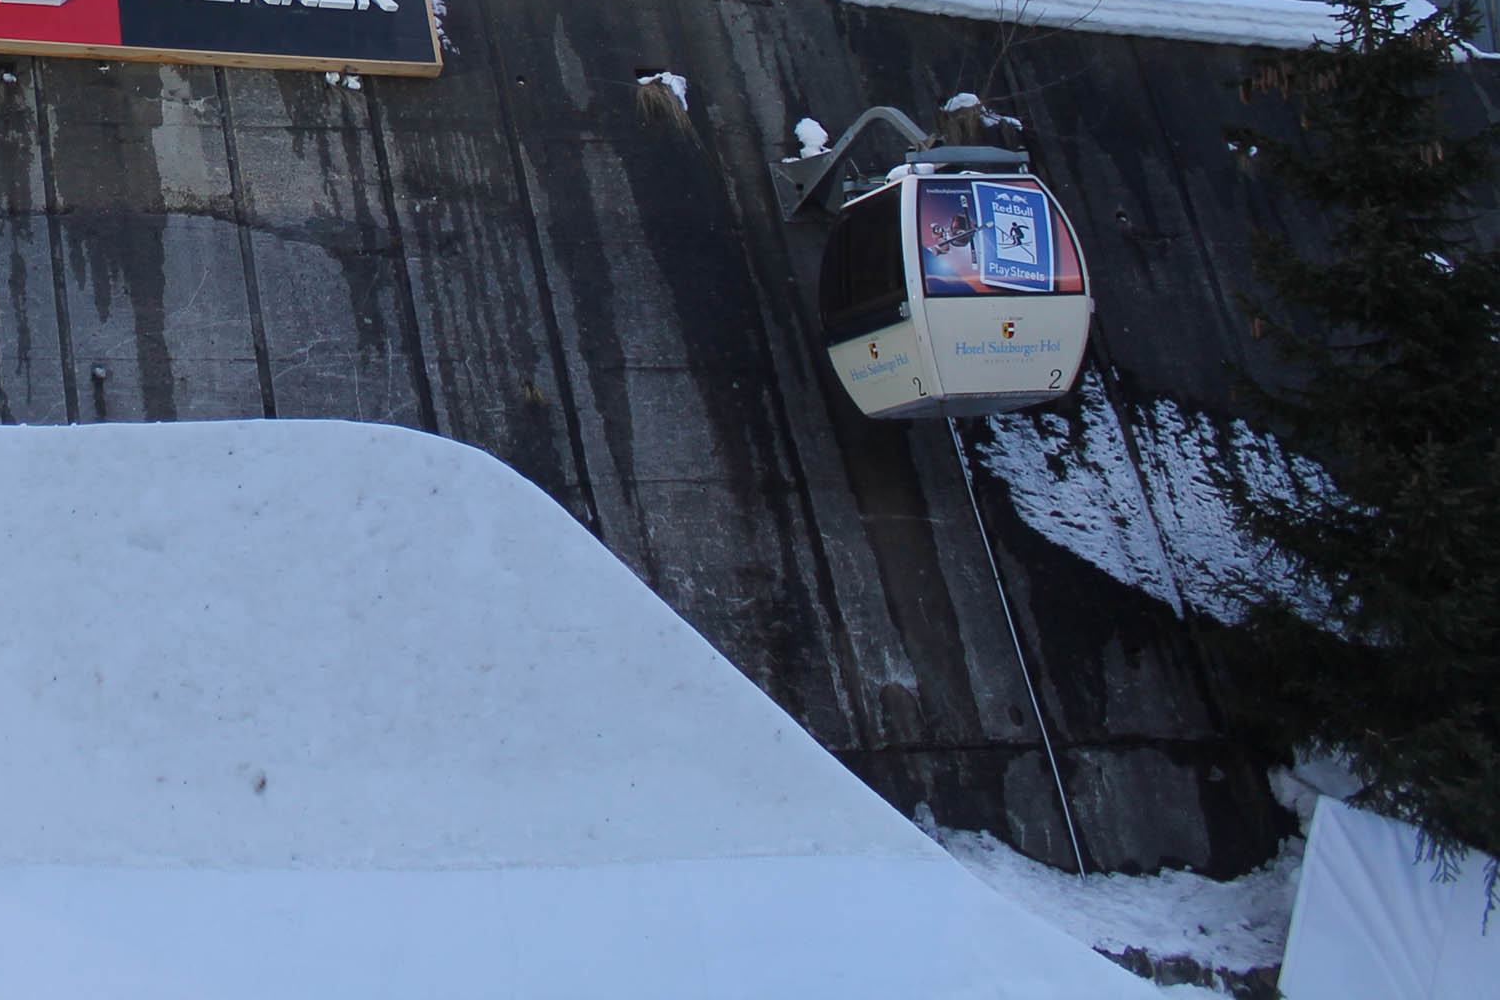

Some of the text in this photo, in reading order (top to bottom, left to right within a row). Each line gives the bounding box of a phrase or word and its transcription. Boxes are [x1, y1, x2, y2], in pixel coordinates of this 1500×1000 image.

[992, 202, 1034, 216] Red Bull
[956, 342, 985, 355] Hotel
[913, 377, 927, 396] 2
[1049, 369, 1062, 389] 2
